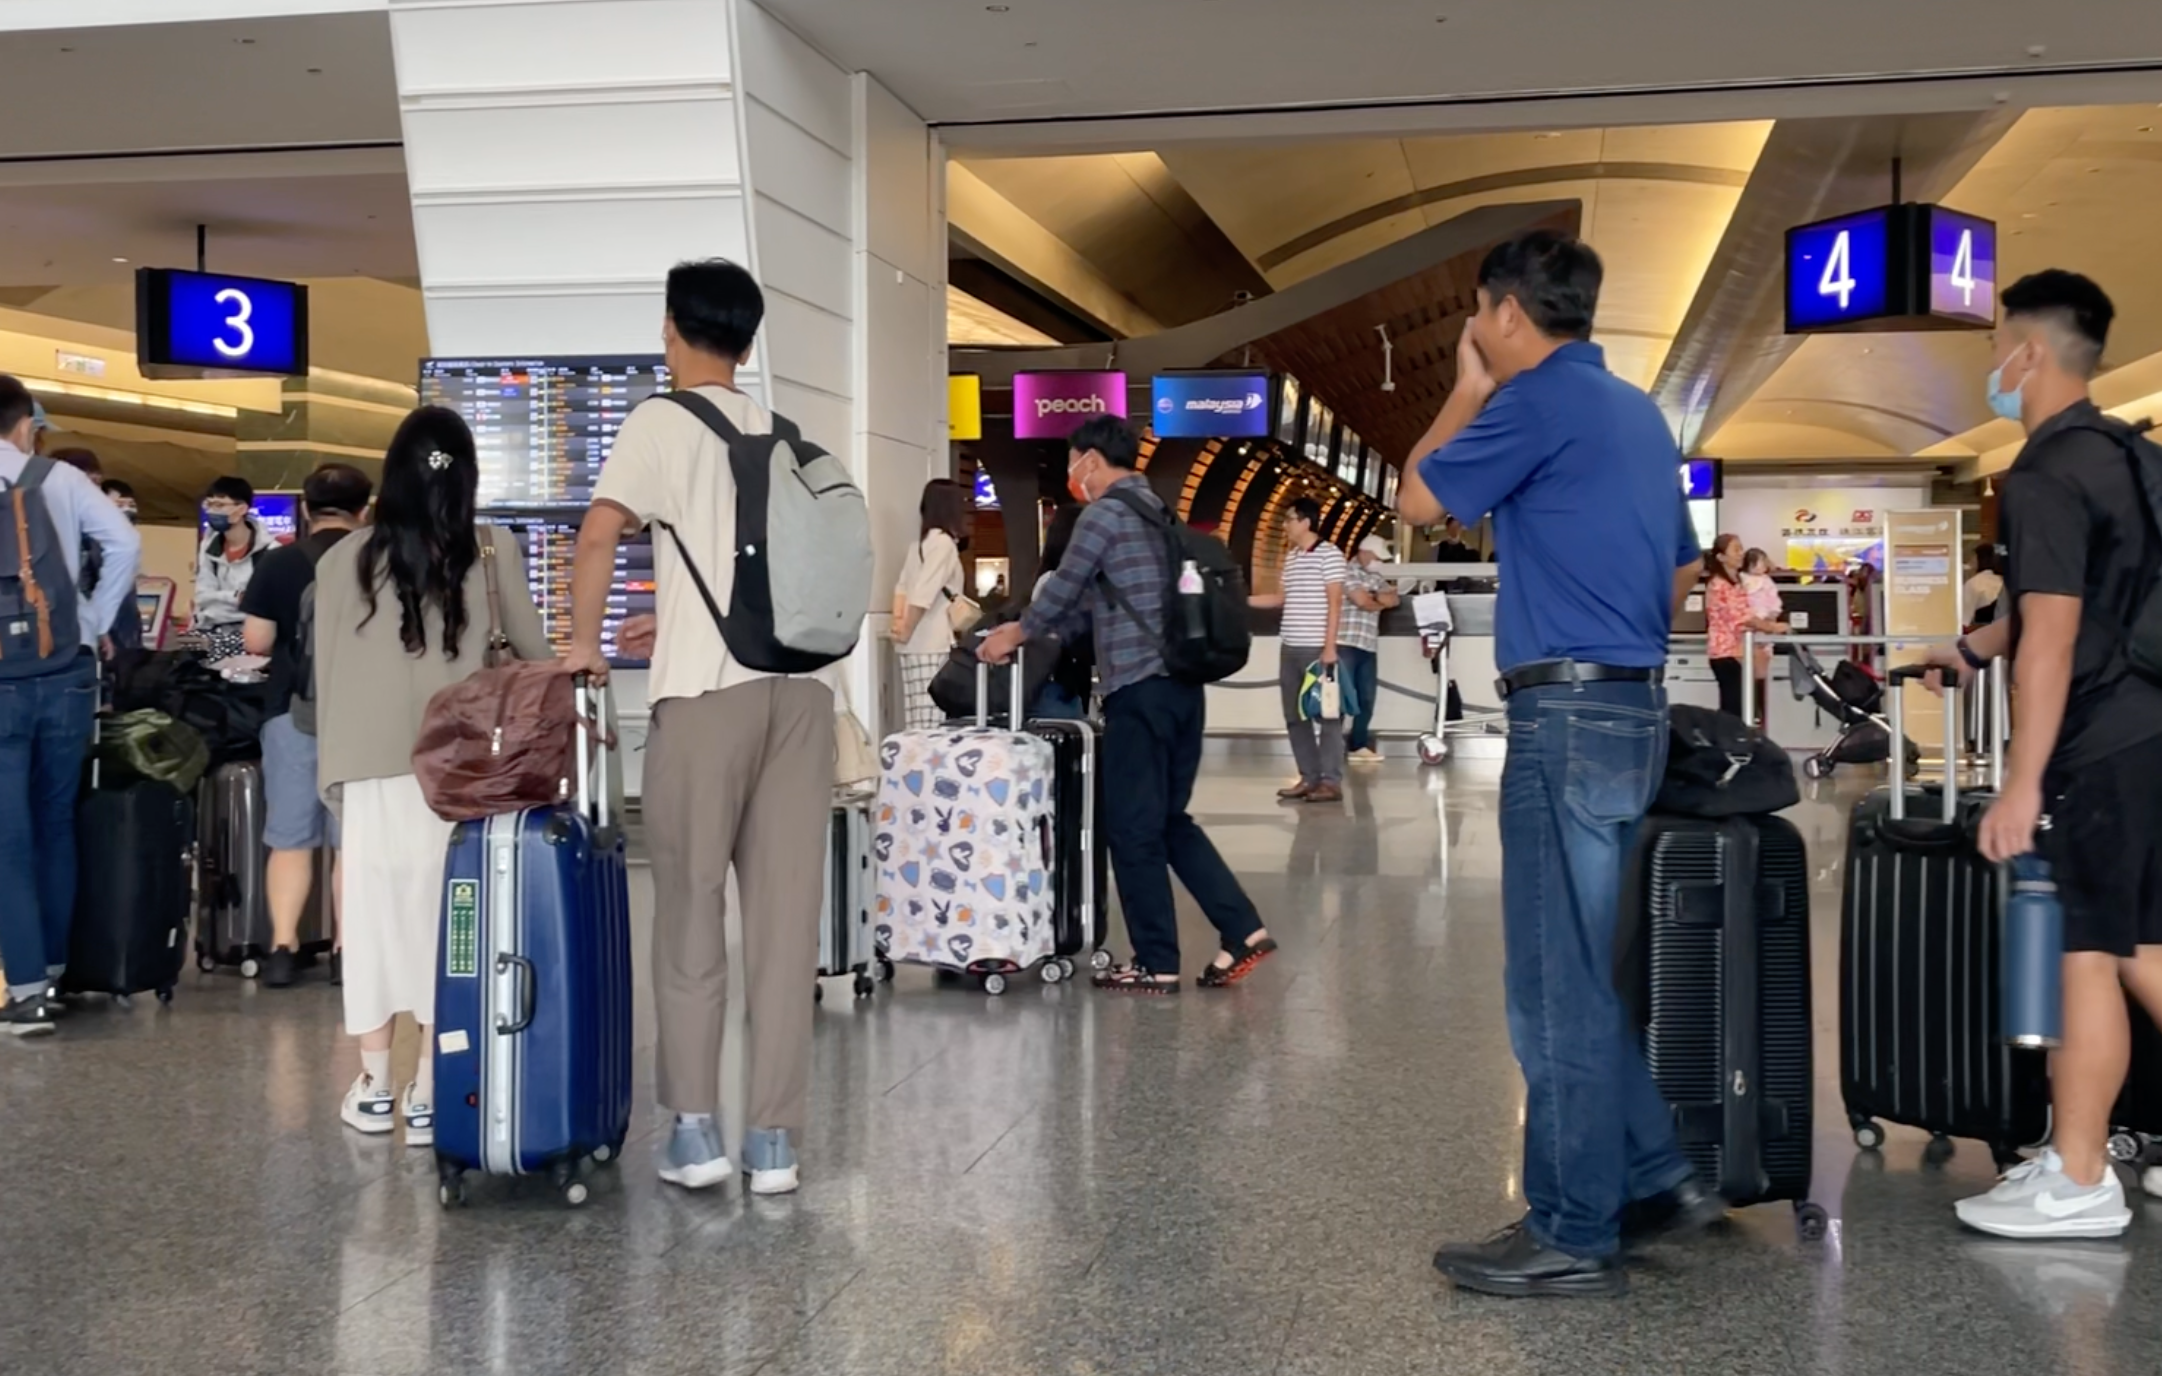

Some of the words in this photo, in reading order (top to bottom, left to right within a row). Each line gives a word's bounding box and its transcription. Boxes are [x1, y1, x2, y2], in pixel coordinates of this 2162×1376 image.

[1818, 229, 1856, 309] 4
[1950, 228, 1976, 307] 4
[212, 287, 254, 356] 3
[1035, 394, 1106, 418] peach
[1185, 399, 1244, 413] malaysia
